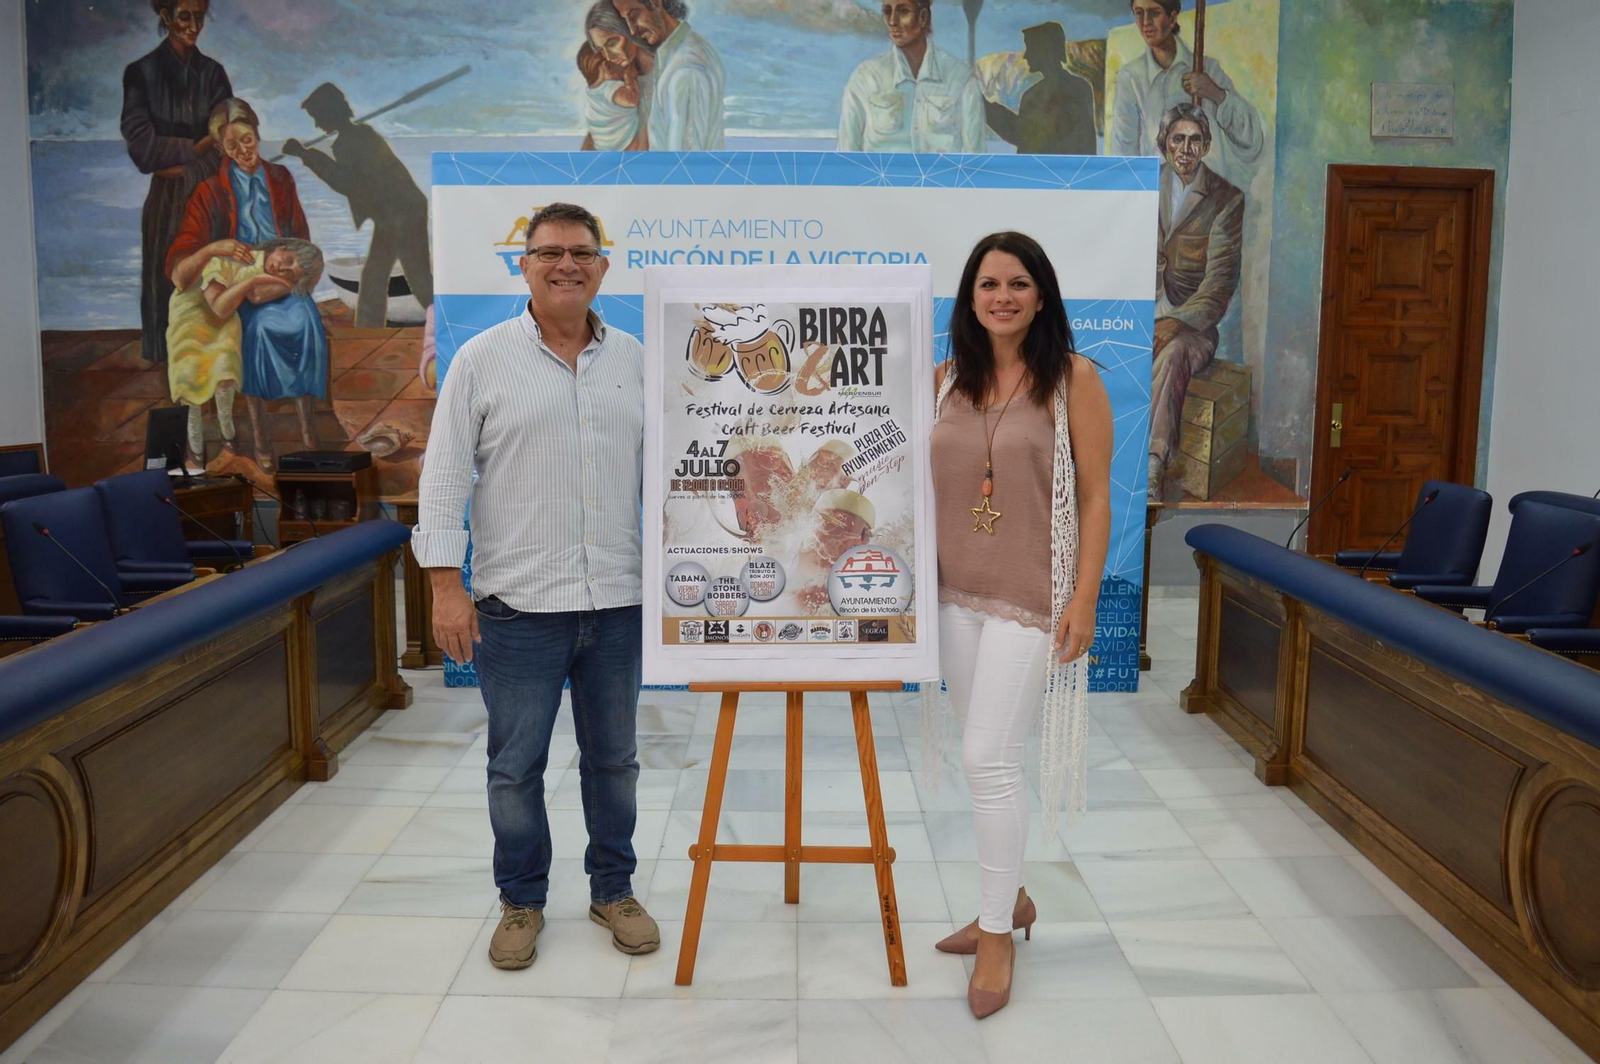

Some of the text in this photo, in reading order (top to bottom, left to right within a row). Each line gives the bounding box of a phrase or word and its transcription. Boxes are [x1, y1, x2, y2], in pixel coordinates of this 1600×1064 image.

[626, 219, 823, 239] AYUNTAMIENTO
[627, 244, 724, 269] RINCÓN
[730, 250, 763, 265] DE
[808, 250, 928, 265] VICTORIA
[799, 306, 888, 349] BIRRA
[1072, 316, 1134, 331] GALBÓN
[830, 346, 888, 388] ART
[685, 401, 890, 418] Festival de Cerveza Artesana
[722, 418, 856, 437] Craft Beer Festival
[853, 419, 900, 452] PLAZA DEL
[686, 440, 700, 457] 4
[716, 440, 730, 457] 7
[841, 430, 907, 476] AYUNTAMIENTO
[674, 459, 741, 477] JULIO
[840, 597, 897, 605] AYUNTAMIENTO
